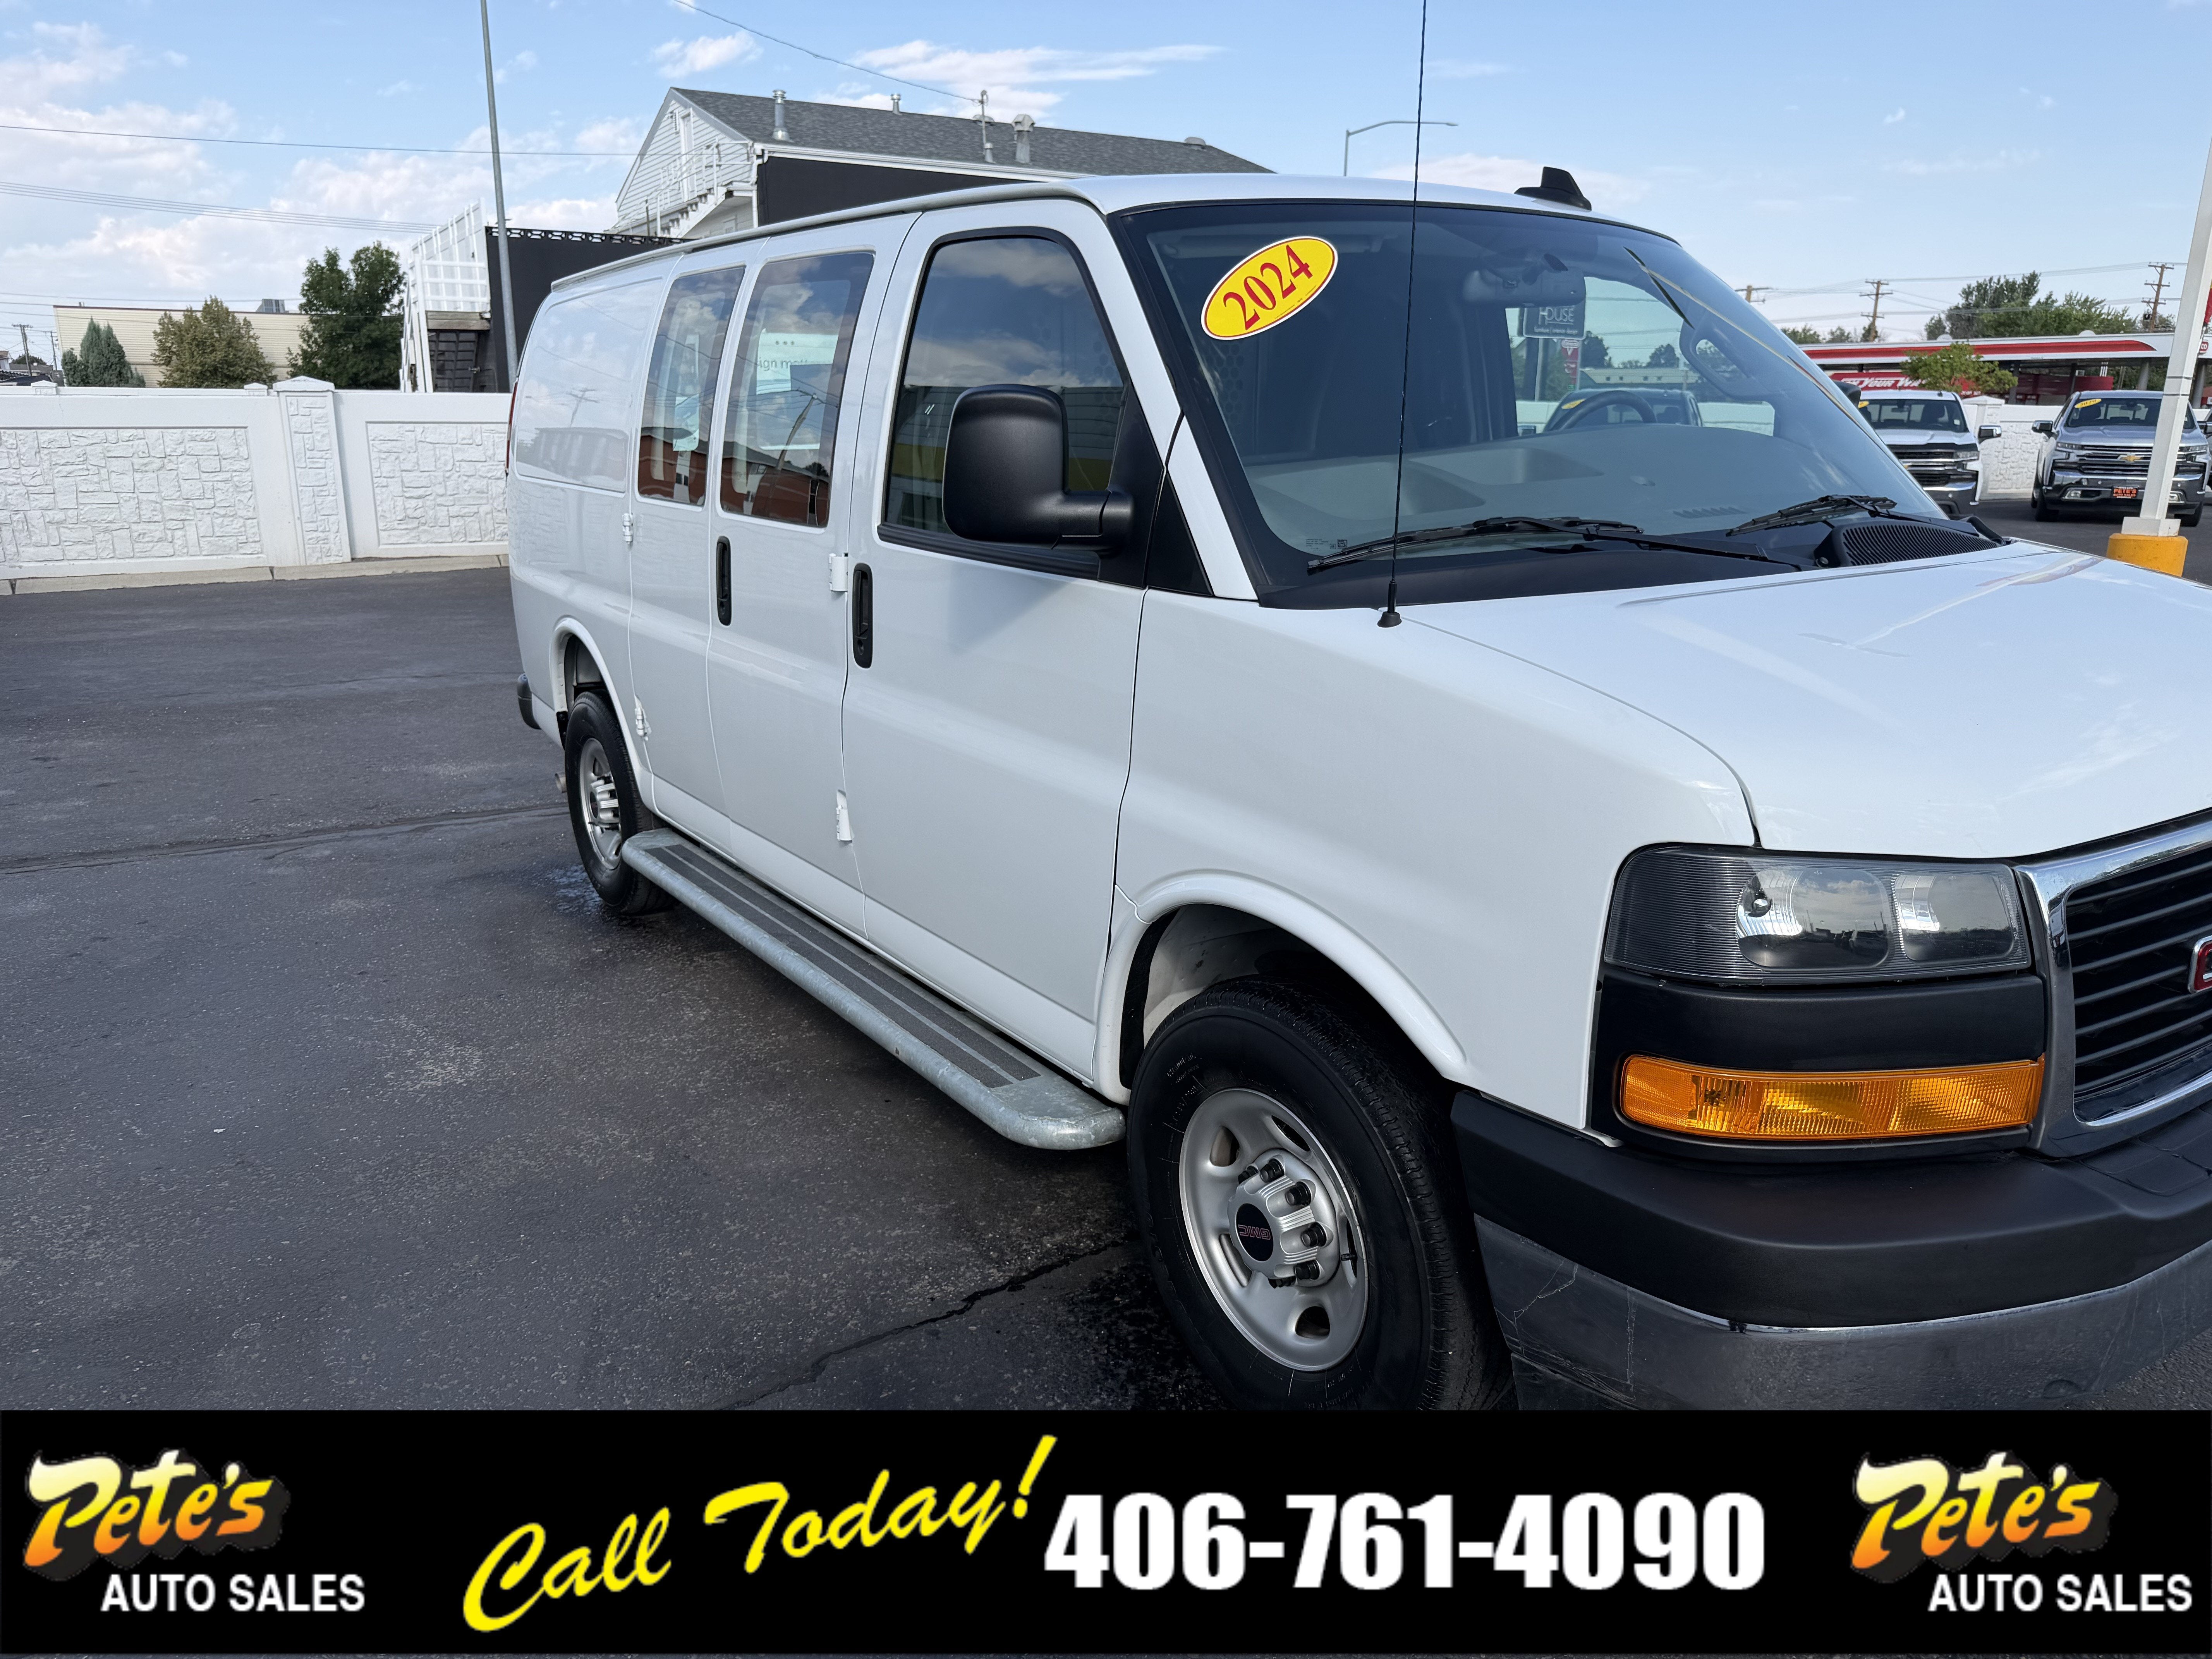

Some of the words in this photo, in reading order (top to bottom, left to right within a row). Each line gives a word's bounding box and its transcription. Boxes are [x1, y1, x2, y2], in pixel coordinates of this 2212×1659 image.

[1223, 244, 1313, 330] 2024
[1539, 307, 1574, 325] HOUSE
[1238, 1224, 1271, 1240] GMC
